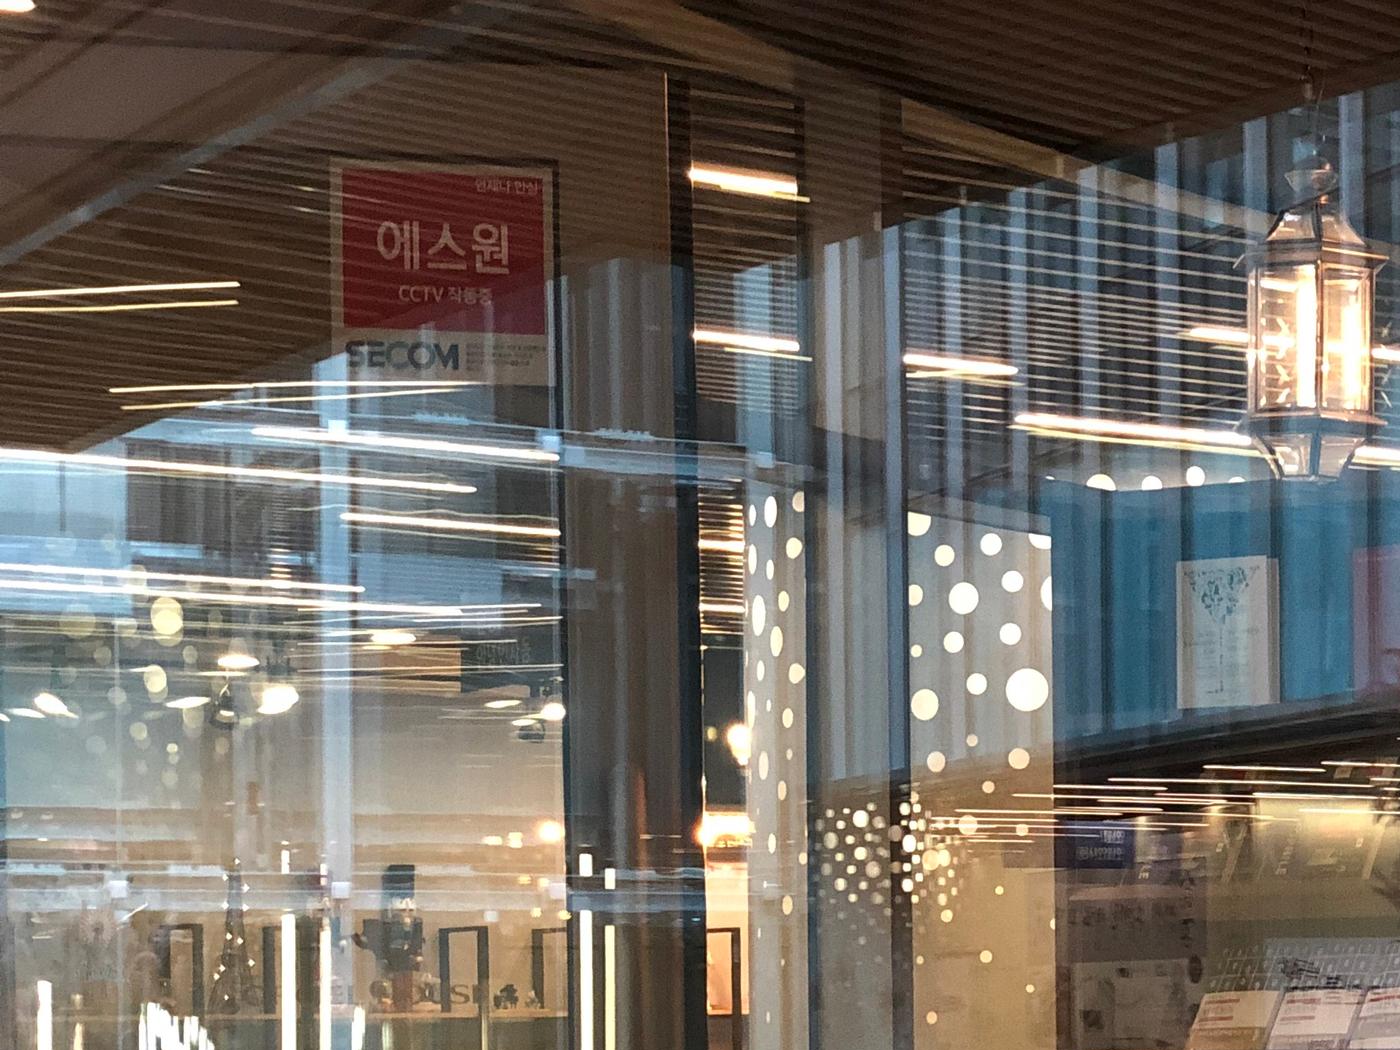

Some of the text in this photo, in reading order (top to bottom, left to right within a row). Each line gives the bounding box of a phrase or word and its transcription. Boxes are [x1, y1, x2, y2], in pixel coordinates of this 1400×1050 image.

[376, 220, 510, 275] 에스원
[398, 284, 443, 303] CCTV
[345, 340, 460, 370] SECOM
